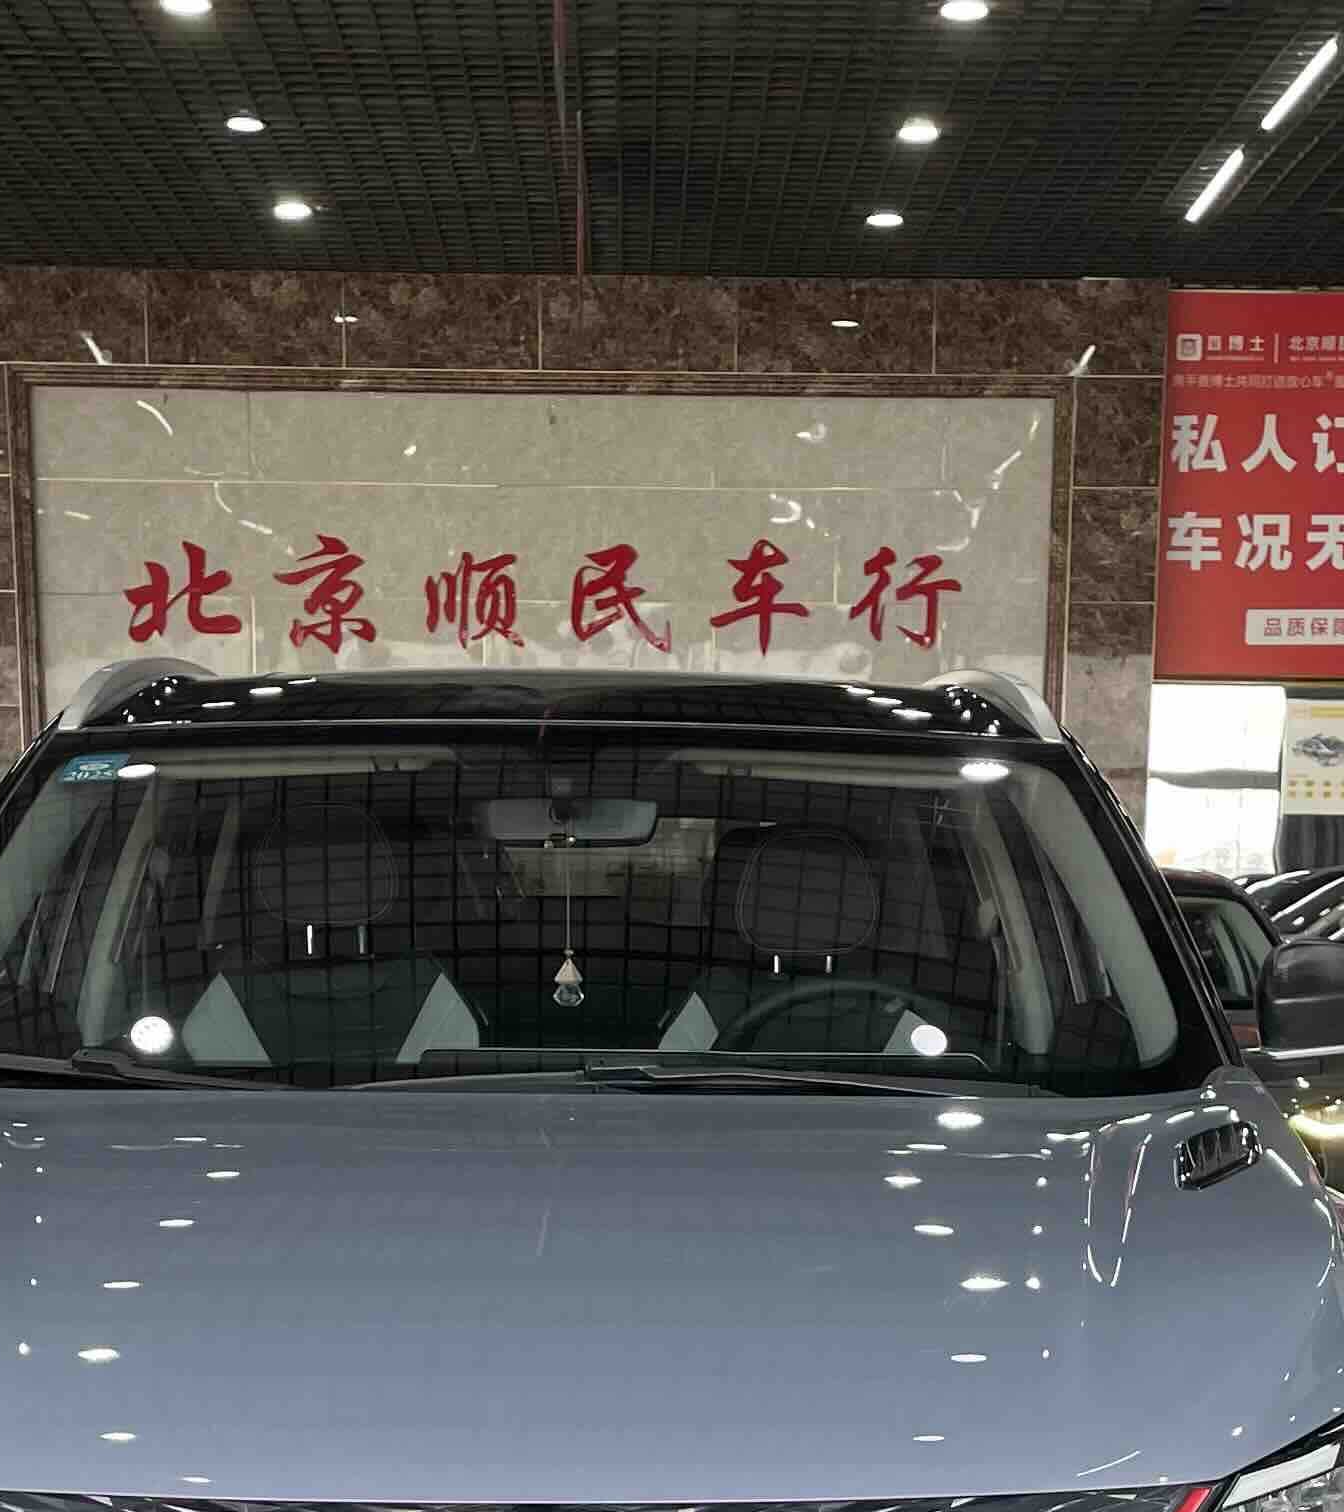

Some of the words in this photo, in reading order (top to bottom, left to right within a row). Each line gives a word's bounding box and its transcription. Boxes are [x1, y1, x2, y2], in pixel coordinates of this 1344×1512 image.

[123, 533, 962, 656] 北京顺民车行
